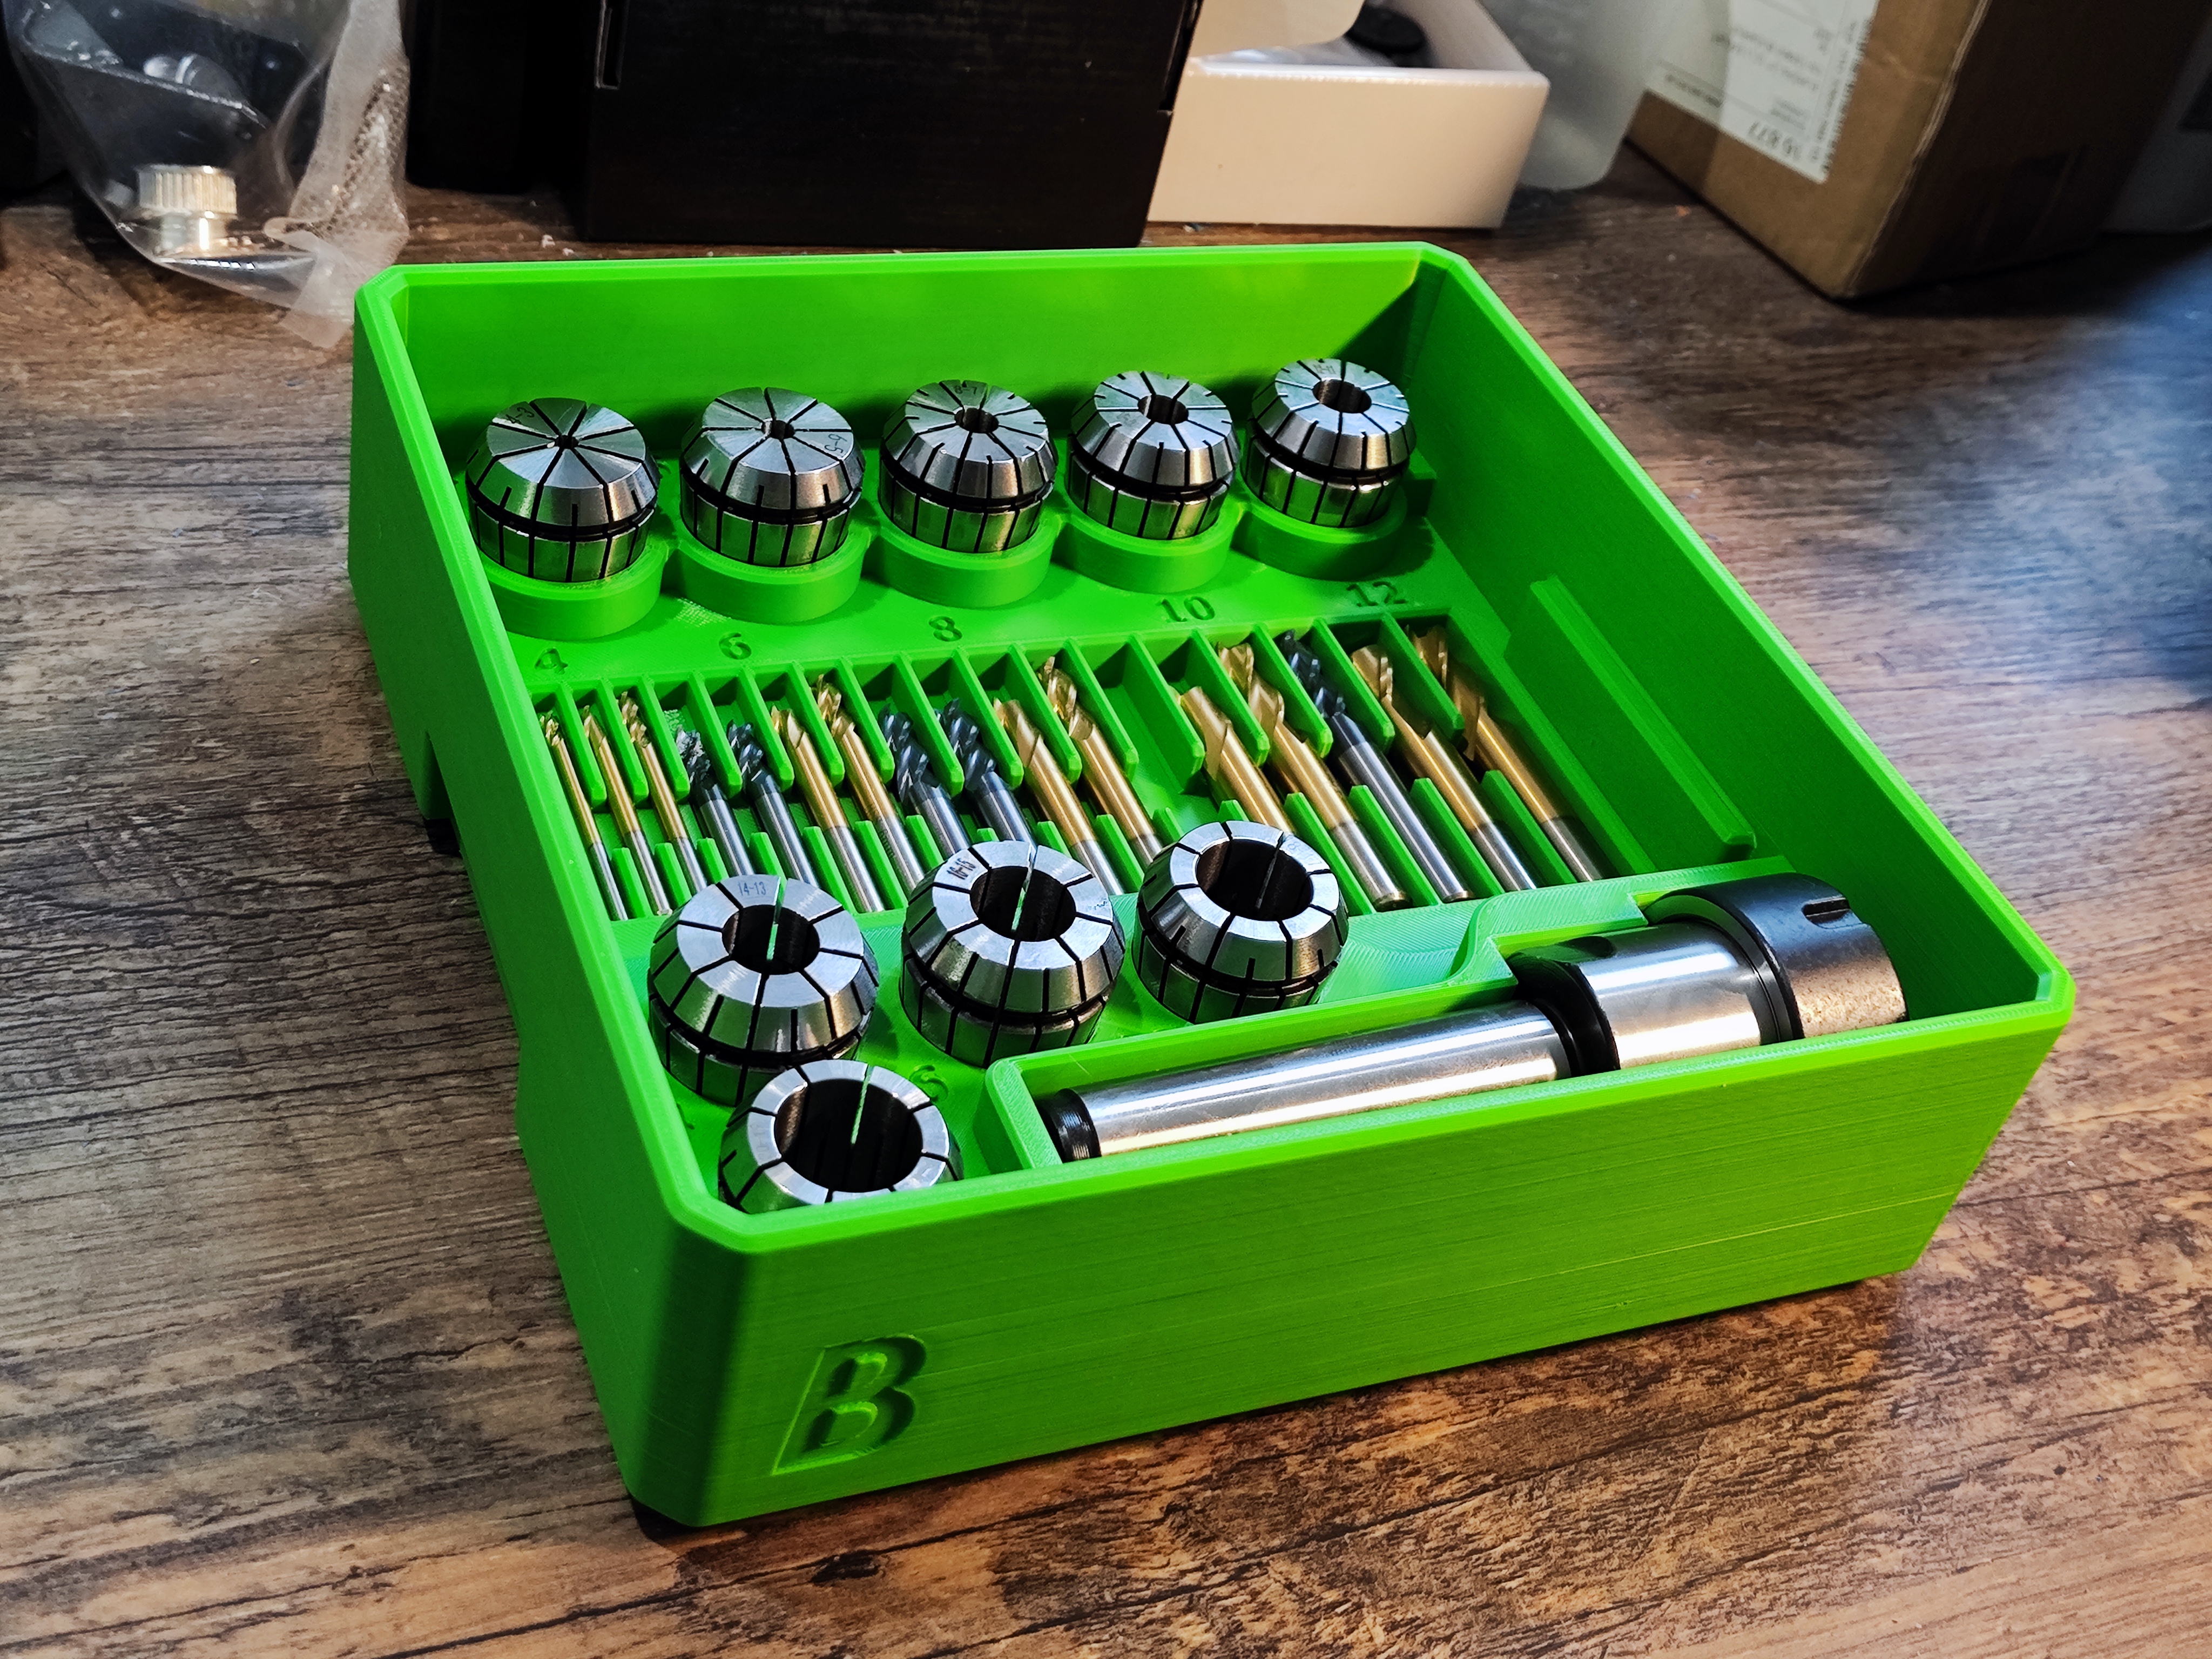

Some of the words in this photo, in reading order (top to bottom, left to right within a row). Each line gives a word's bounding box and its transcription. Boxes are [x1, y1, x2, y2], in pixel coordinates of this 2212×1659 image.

[1345, 581, 1408, 607] 12
[1156, 596, 1215, 622] 10
[929, 615, 963, 643] 8
[718, 631, 752, 660] 6
[534, 648, 569, 675] 4
[737, 881, 767, 896] 14-13
[770, 1332, 927, 1476] B
